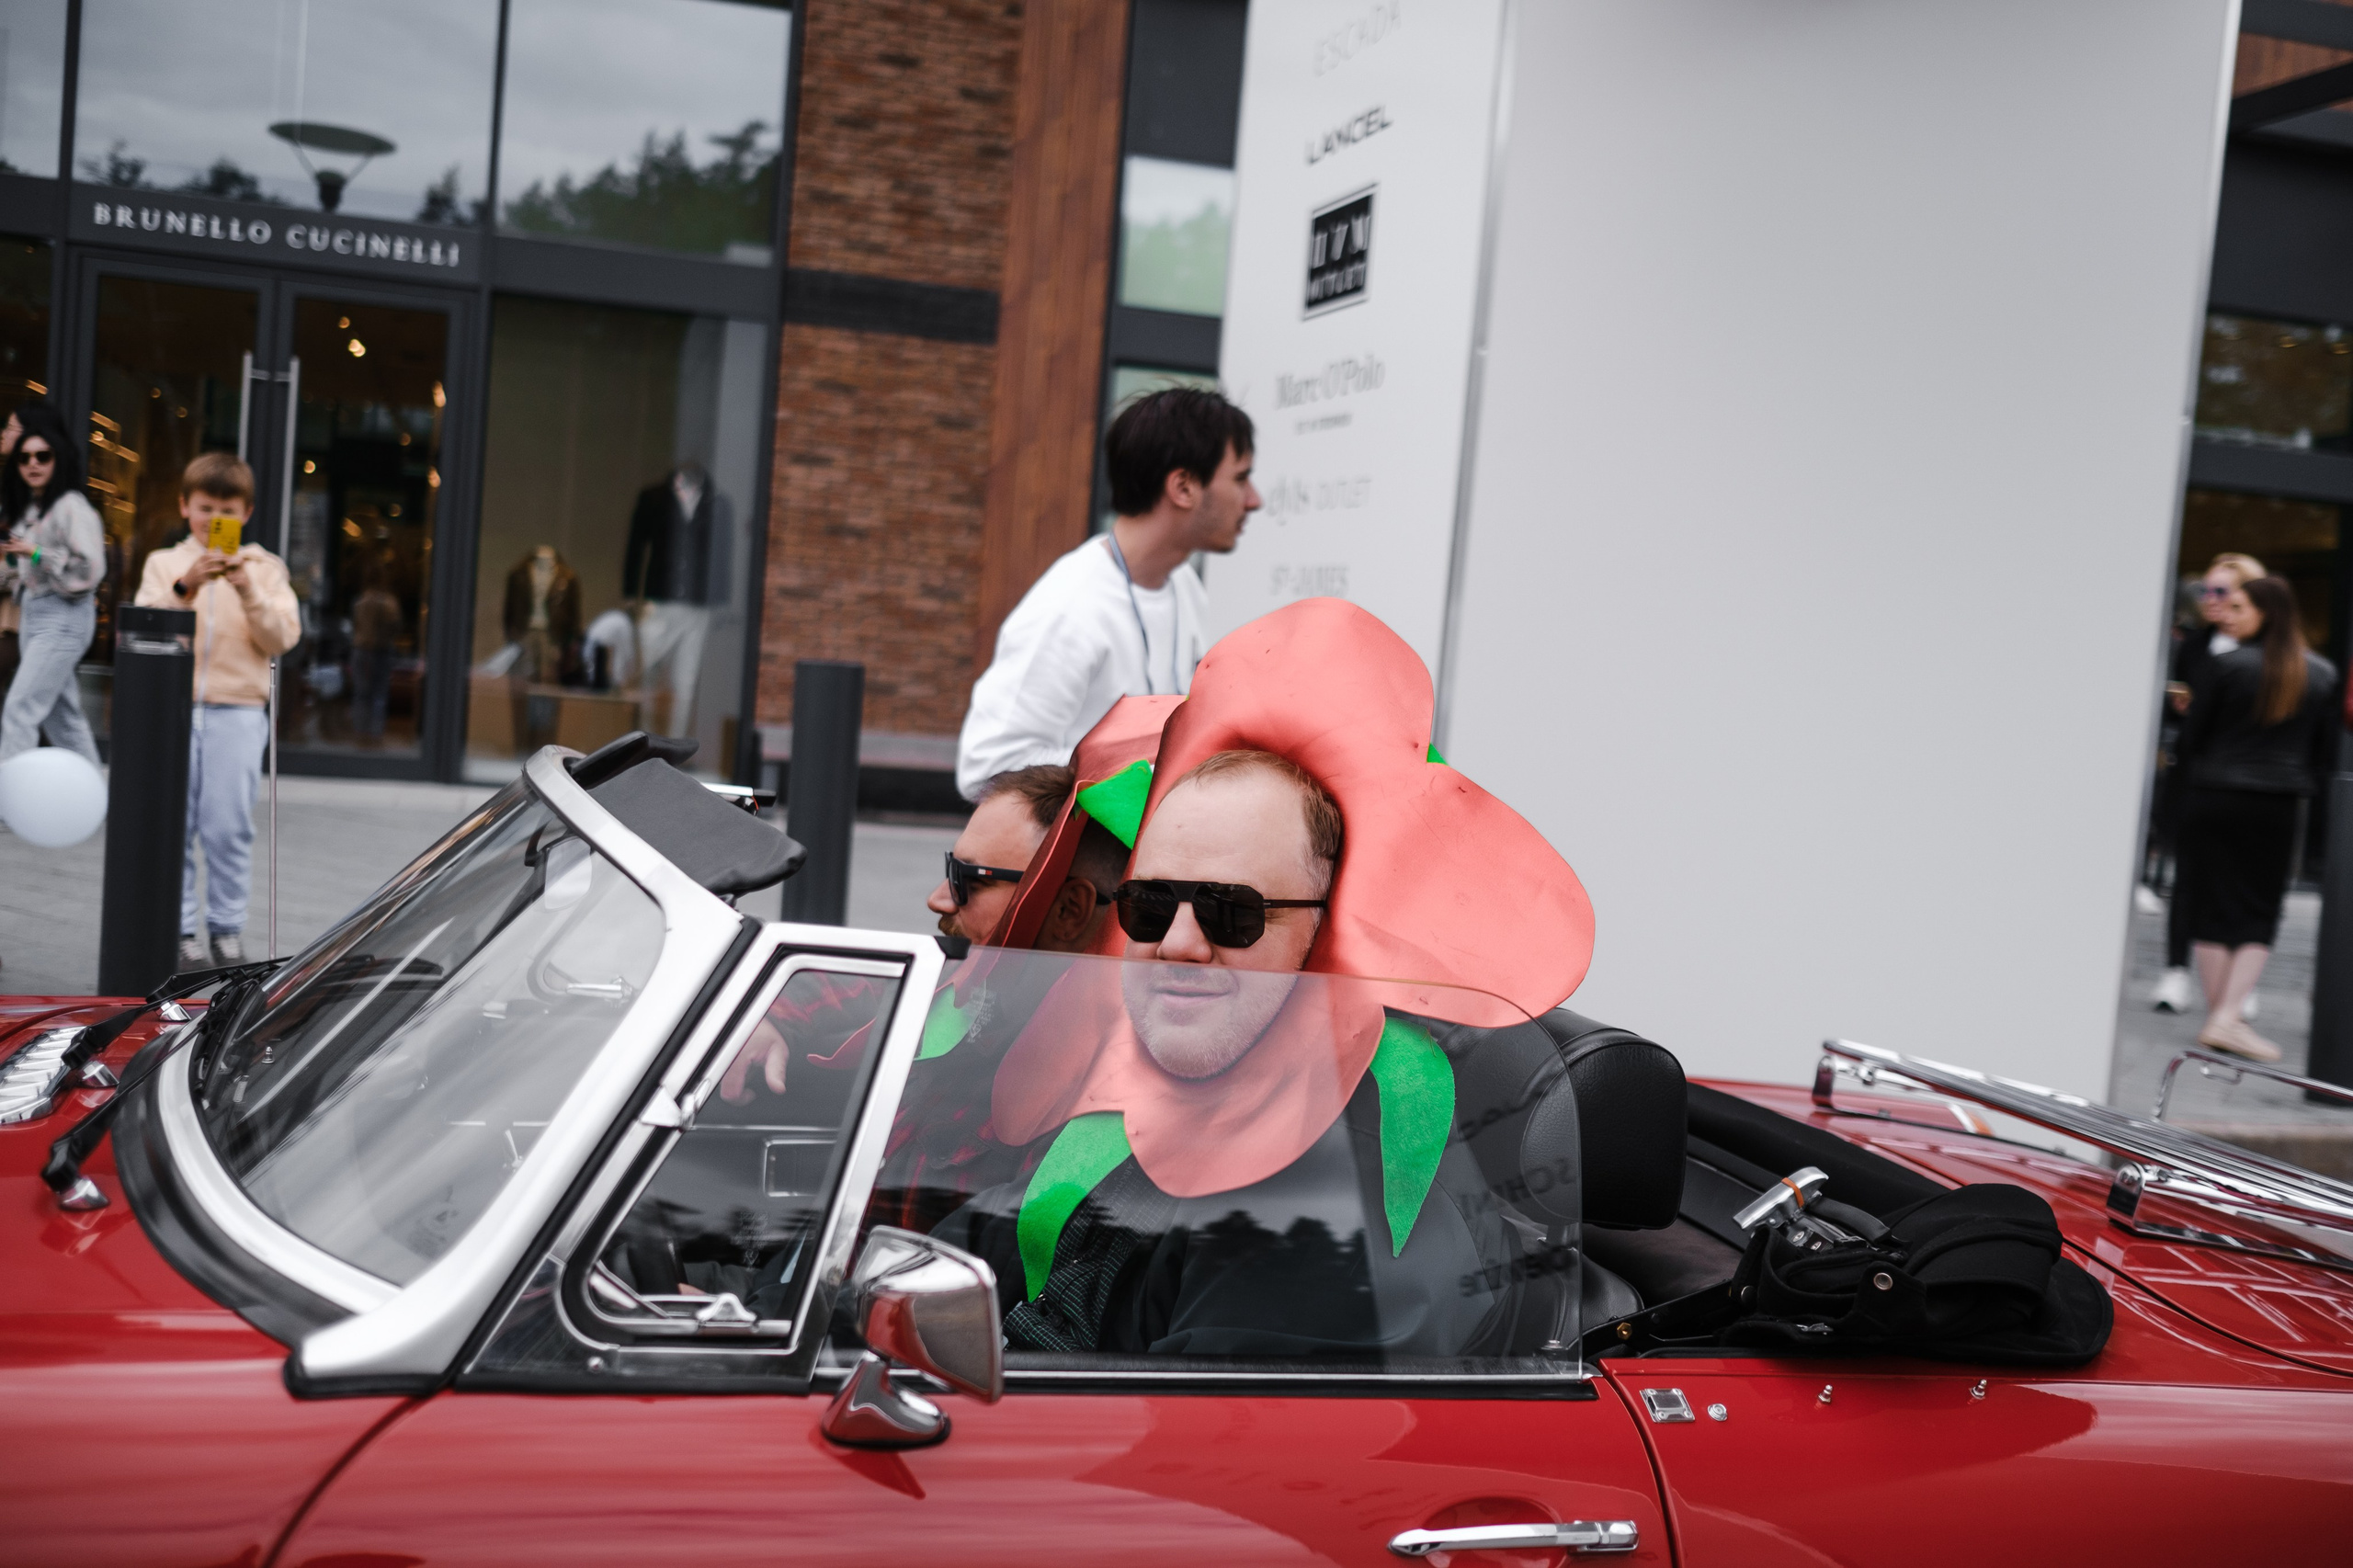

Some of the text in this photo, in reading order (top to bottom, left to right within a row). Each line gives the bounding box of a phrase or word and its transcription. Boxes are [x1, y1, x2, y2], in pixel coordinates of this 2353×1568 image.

[1305, 105, 1394, 166] LANCEL
[94, 201, 460, 268] BRUNELLO CUCINELLI
